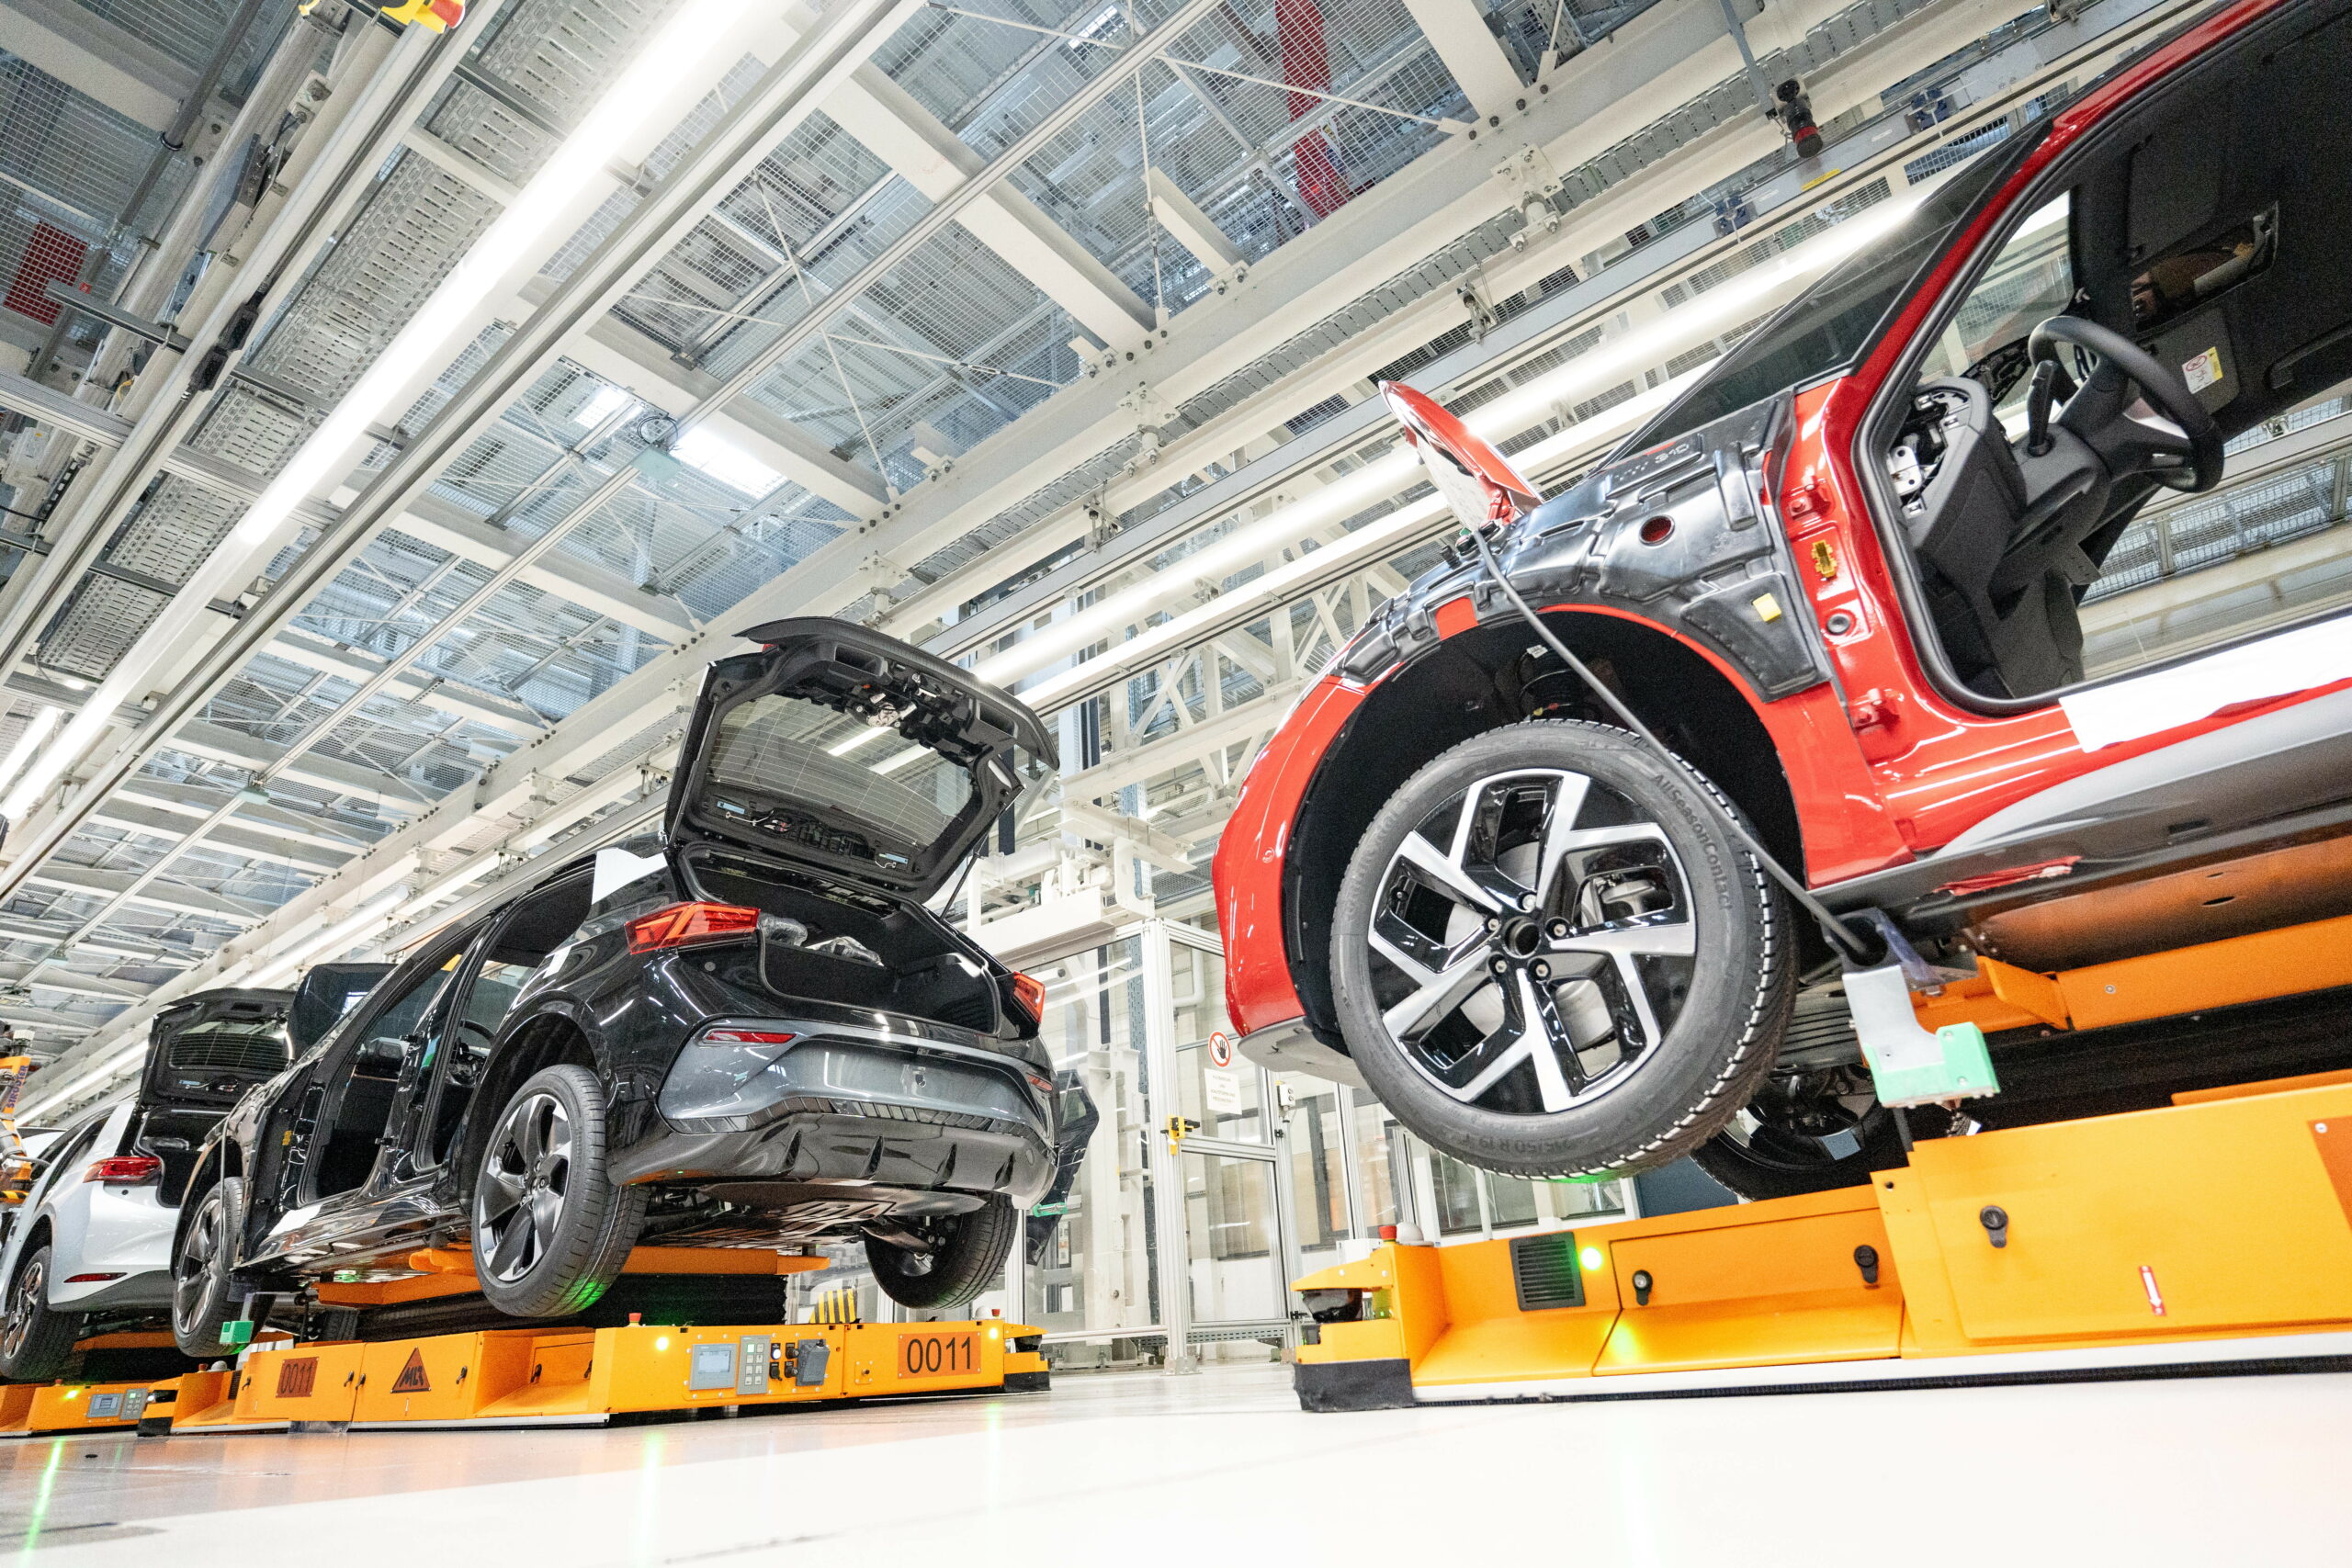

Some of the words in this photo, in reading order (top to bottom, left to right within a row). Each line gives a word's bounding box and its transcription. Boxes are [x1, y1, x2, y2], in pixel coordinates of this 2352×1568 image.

[1654, 774, 1733, 910] AllSeasonContact
[906, 1336, 971, 1373] 0011
[280, 1362, 313, 1394] 0011
